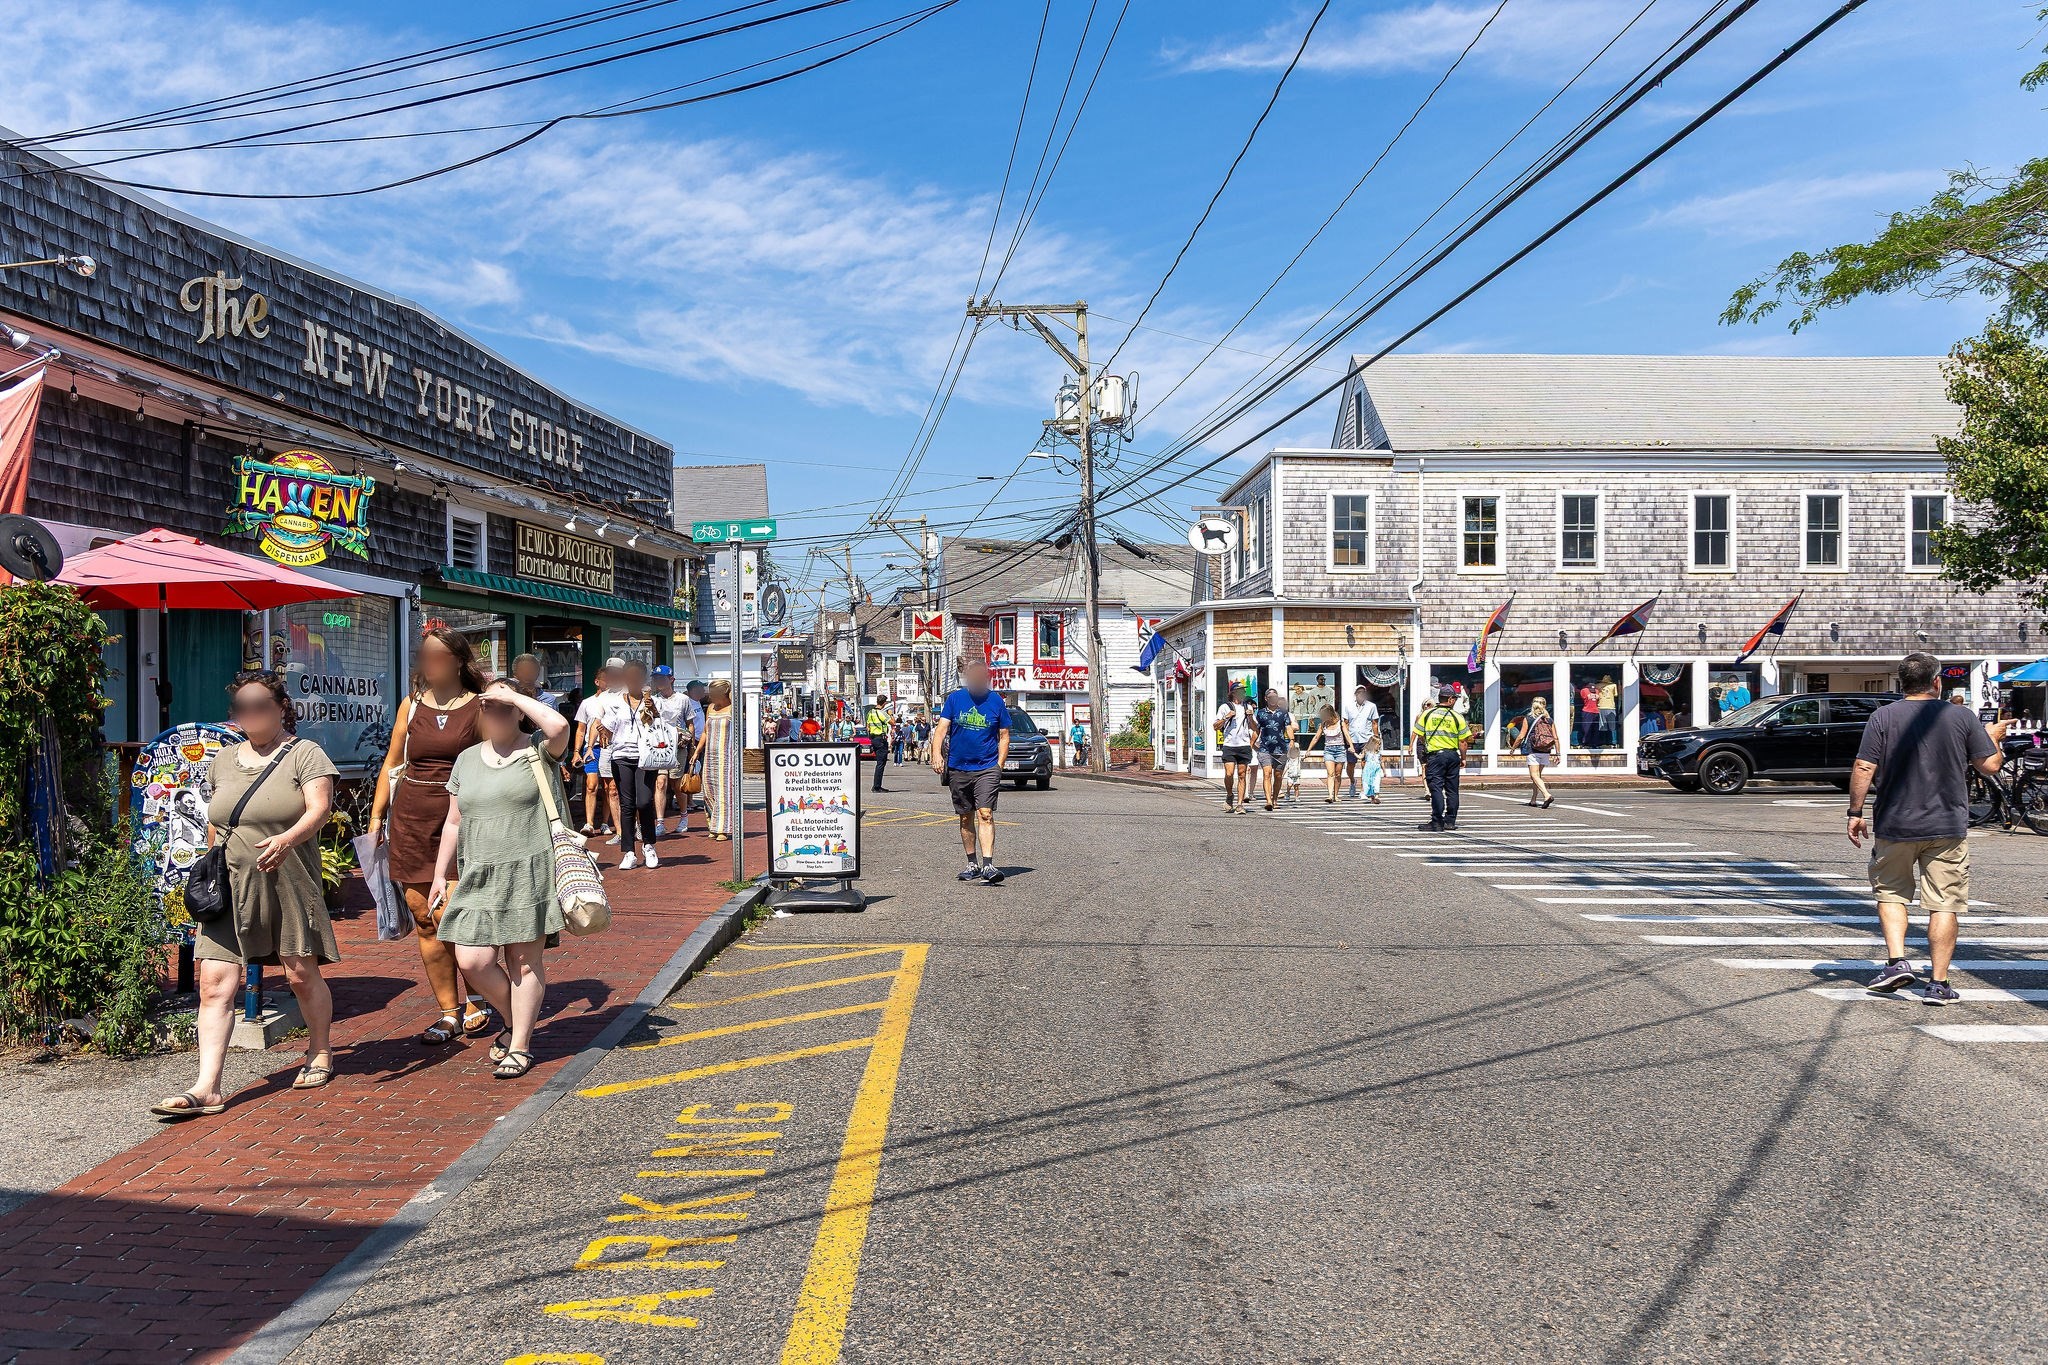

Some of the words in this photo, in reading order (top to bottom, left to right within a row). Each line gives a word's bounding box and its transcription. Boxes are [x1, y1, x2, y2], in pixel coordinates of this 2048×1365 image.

[180, 270, 269, 343] The
[303, 319, 393, 399] NEW
[412, 367, 495, 441] YORK
[509, 407, 584, 473] STORE
[279, 517, 313, 529] CANNABIS
[730, 525, 739, 536] P
[265, 544, 321, 563] DISPENSARY
[519, 526, 555, 556] LEWIS
[558, 536, 612, 570] BROTHERS
[519, 554, 570, 582] HOMEMADE
[572, 566, 585, 585] ICE
[586, 569, 612, 590] CREAM
[1948, 668, 1965, 677] ATM
[300, 674, 378, 697] CANNABIS
[1039, 680, 1086, 690] STEAKS
[295, 702, 384, 723] DISPENSARY
[153, 747, 173, 758] HULK
[153, 754, 178, 767] HANDS
[775, 753, 800, 767] GO
[804, 753, 851, 767] SLOW
